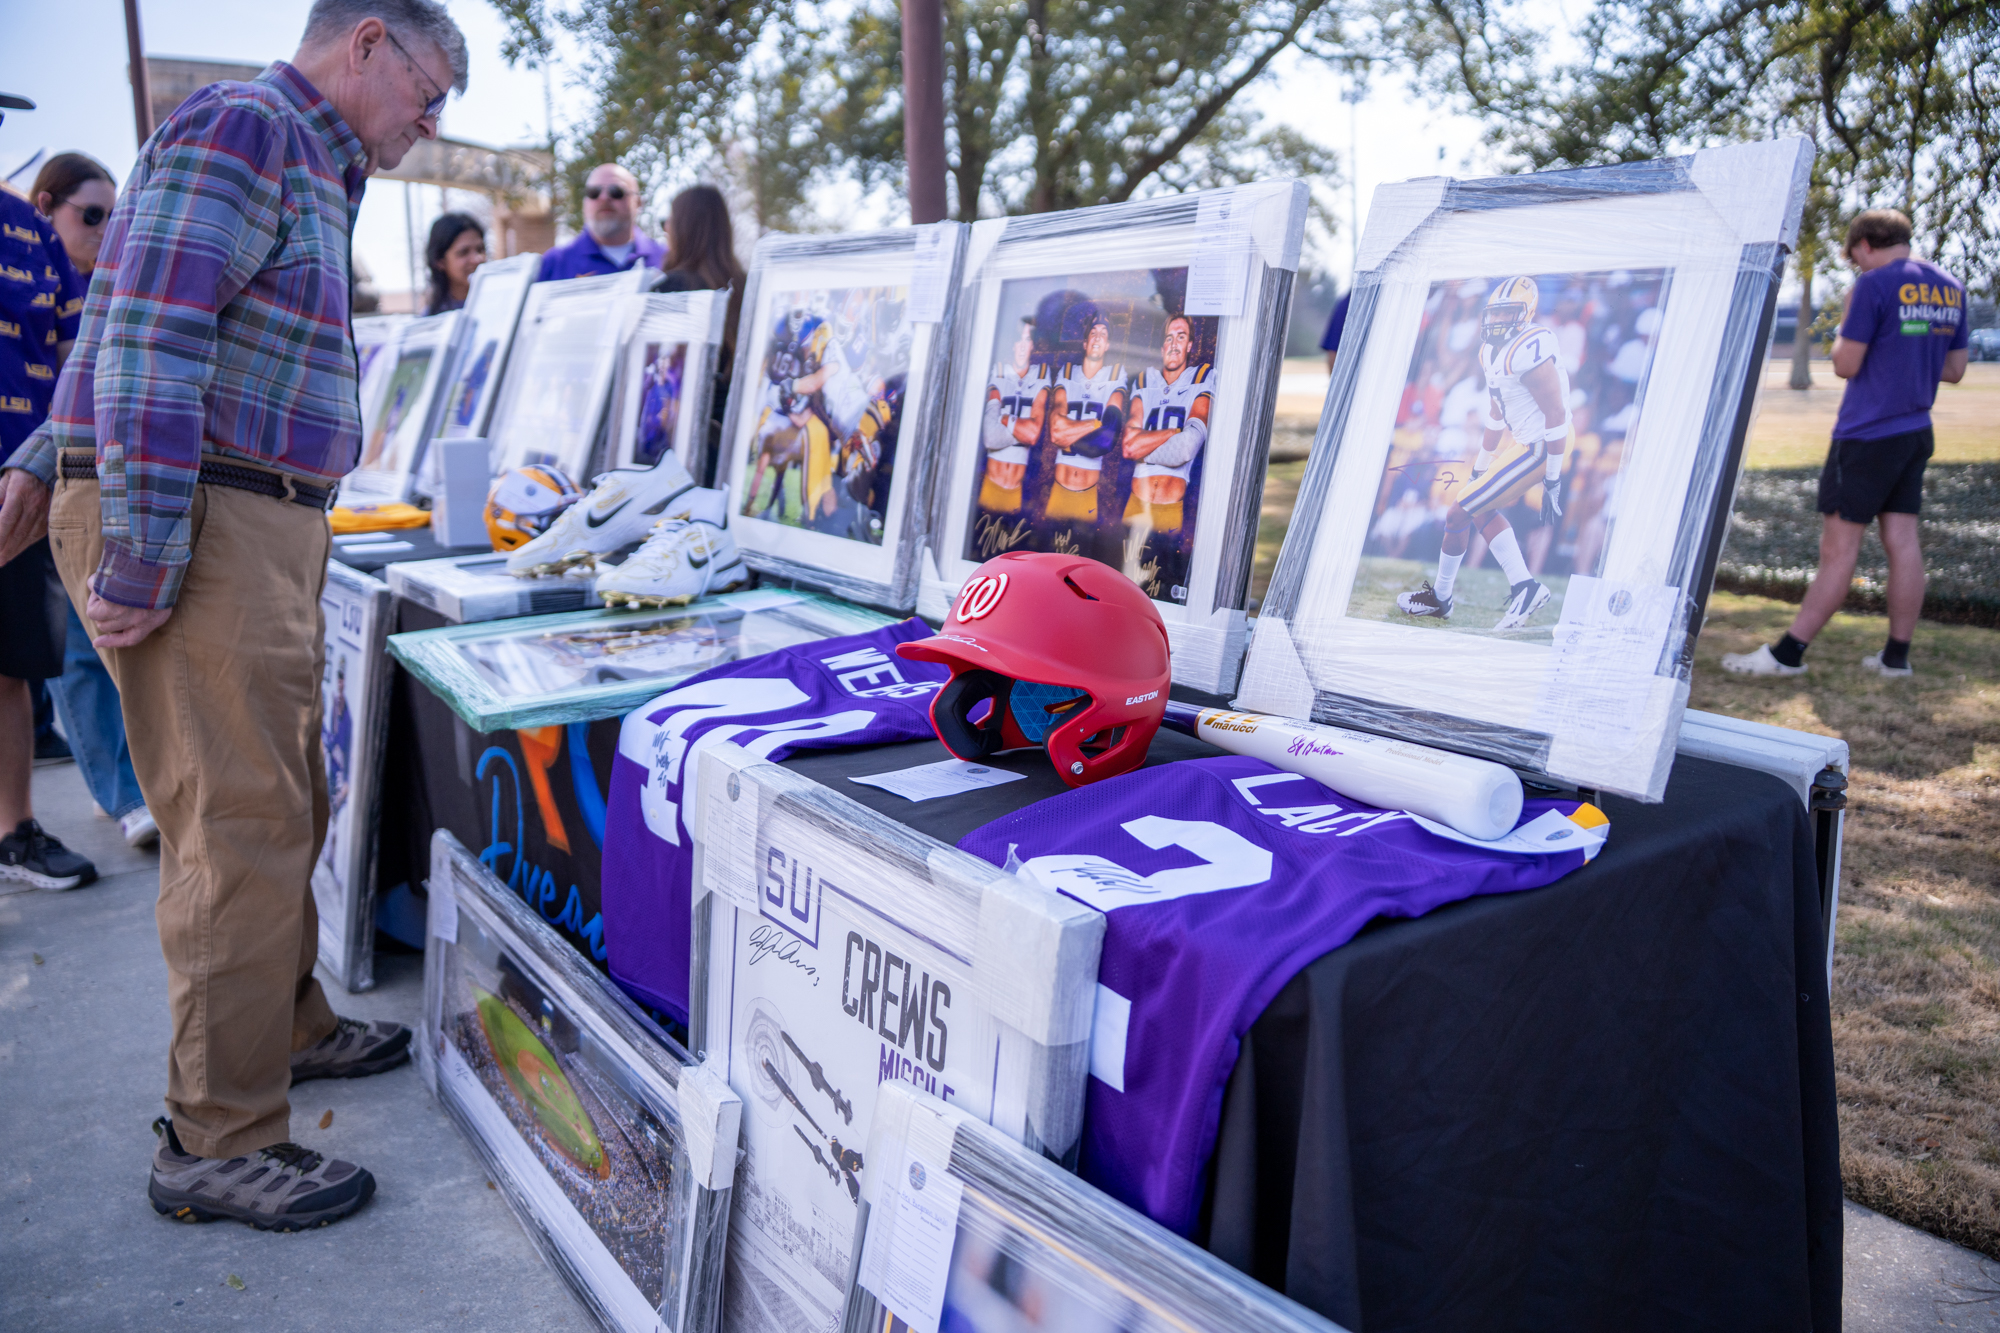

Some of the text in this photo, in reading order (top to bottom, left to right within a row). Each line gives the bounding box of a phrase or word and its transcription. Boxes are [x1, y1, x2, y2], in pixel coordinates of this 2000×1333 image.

[4, 223, 43, 245] LSU
[31, 292, 56, 308] SU
[0, 319, 22, 340] SU
[1526, 338, 1542, 363] 7
[25, 361, 54, 381] LSU
[0, 395, 33, 415] LSU
[1159, 398, 1170, 406] LSU
[956, 572, 1010, 624] W
[1125, 690, 1159, 706] EASTON
[1211, 721, 1259, 734] marucci
[1422, 755, 1445, 766] Model
[1231, 773, 1412, 837] LACY
[758, 846, 813, 924] SU
[842, 930, 951, 1073] CREWS
